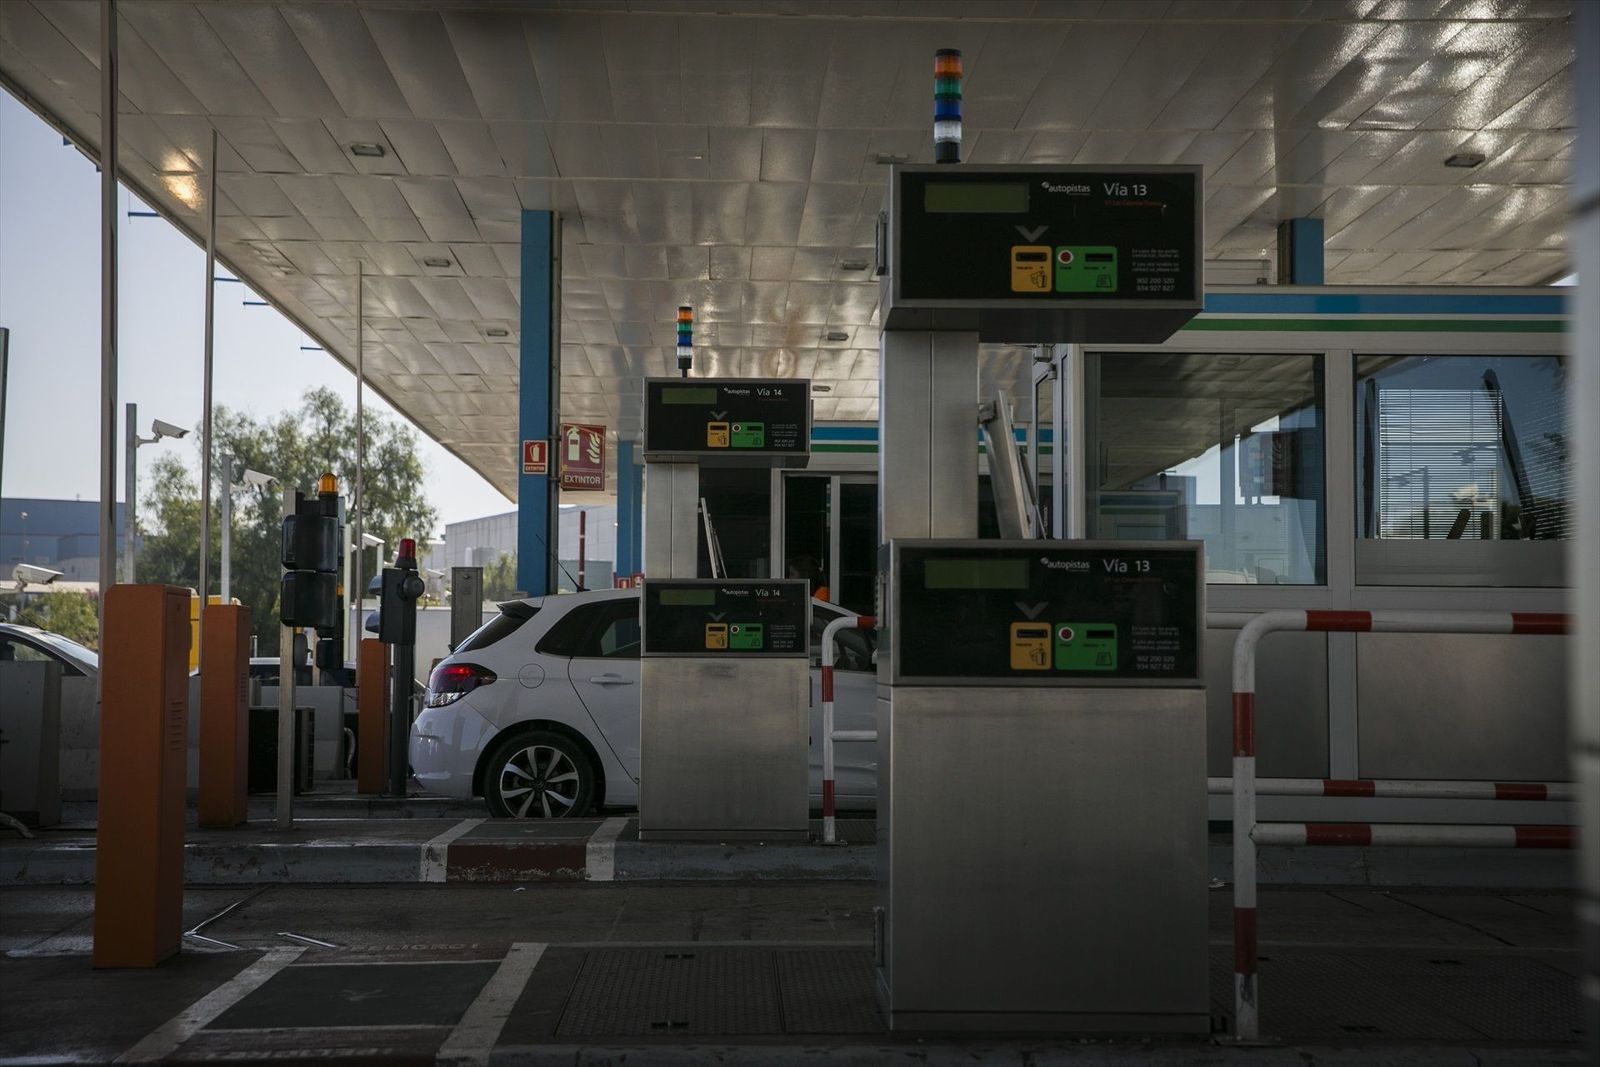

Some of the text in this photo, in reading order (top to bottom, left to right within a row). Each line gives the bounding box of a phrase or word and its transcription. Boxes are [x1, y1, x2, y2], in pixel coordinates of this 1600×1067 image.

[1048, 183, 1091, 194] autopistas
[1104, 182, 1148, 197] Vía 13
[564, 475, 601, 485] EXTINTOR
[1047, 559, 1090, 570] autopistas
[1103, 558, 1150, 573] Vía 13
[772, 589, 781, 597] 14
